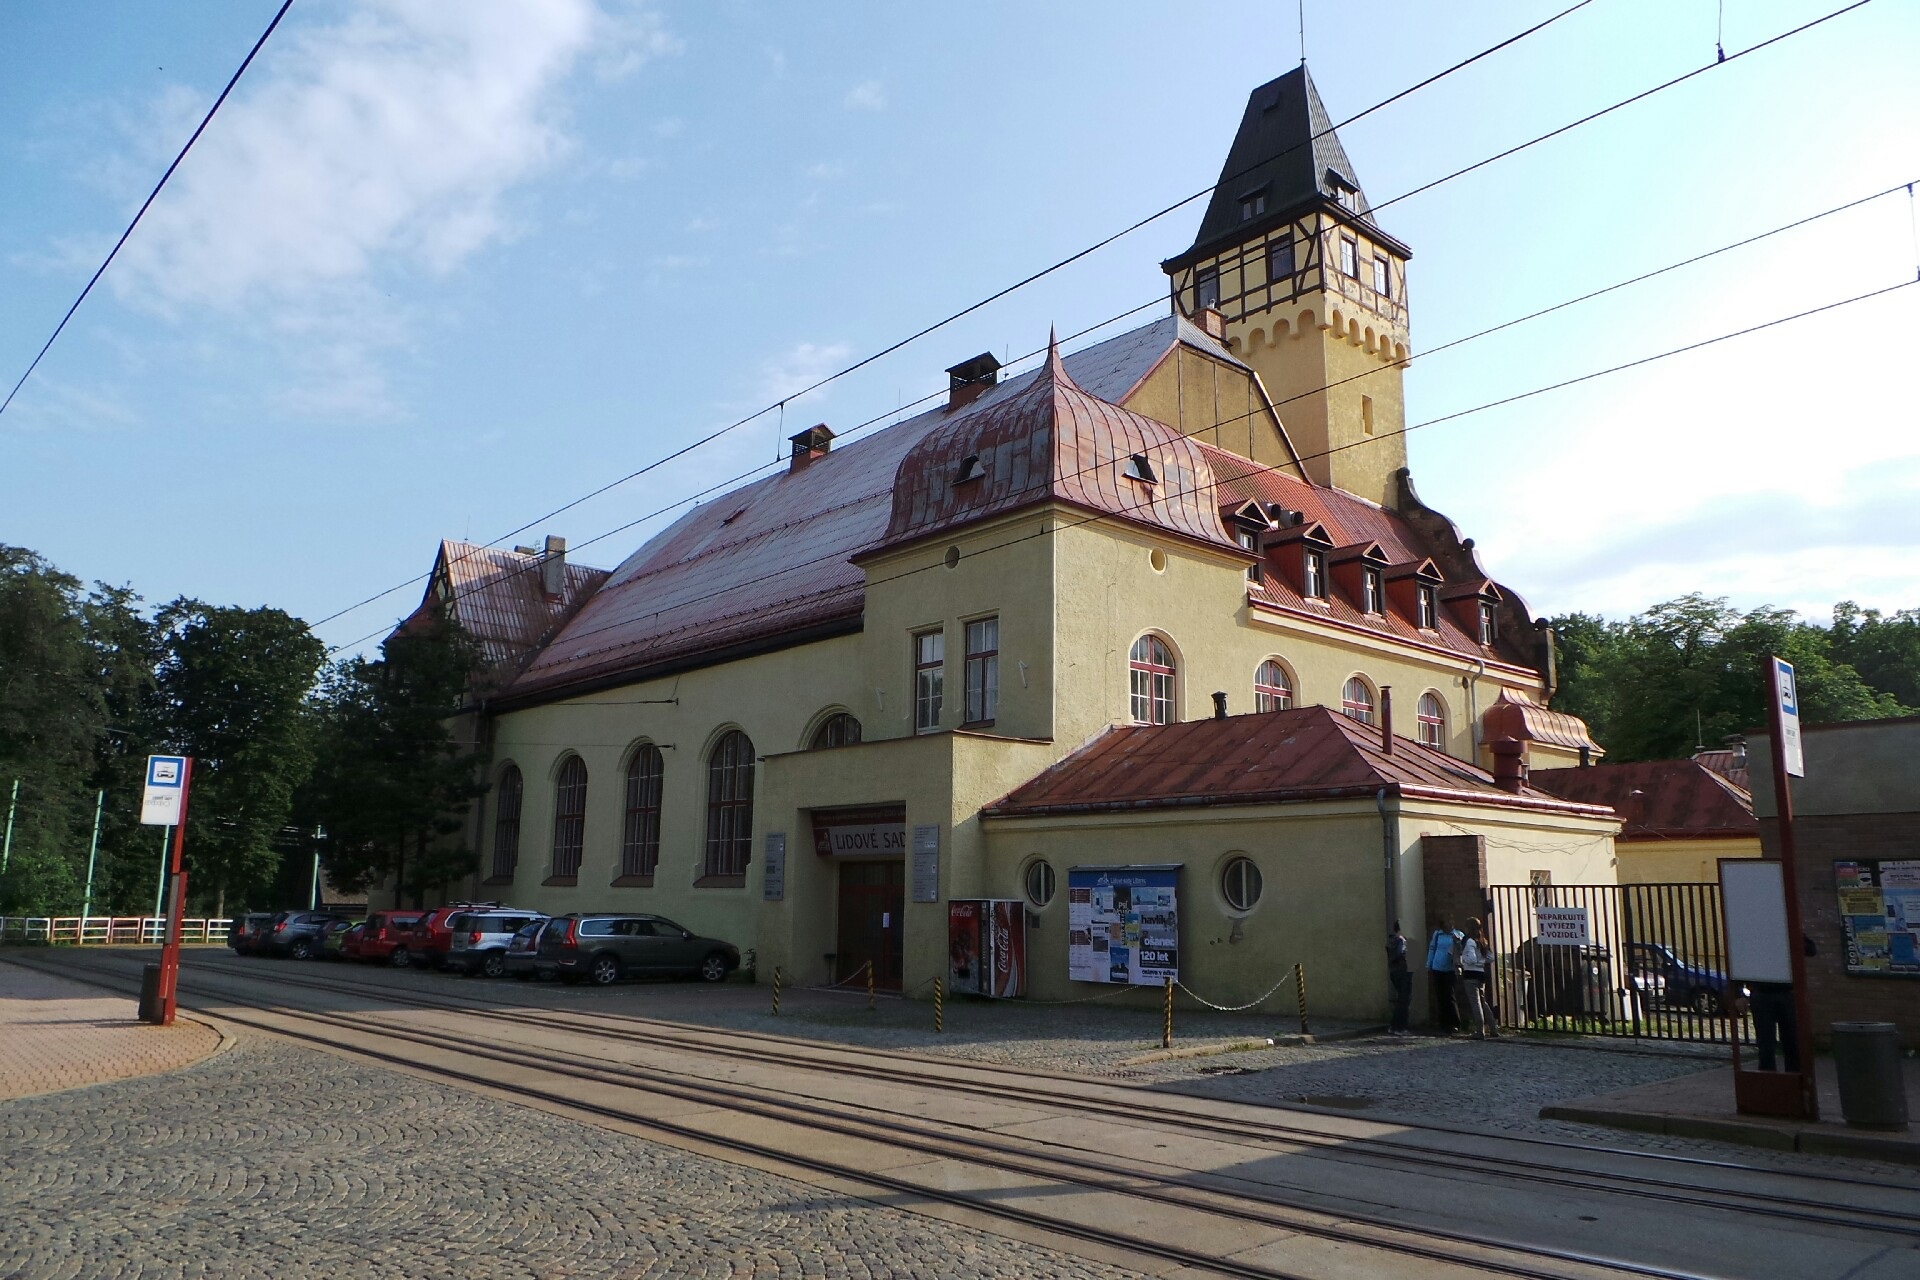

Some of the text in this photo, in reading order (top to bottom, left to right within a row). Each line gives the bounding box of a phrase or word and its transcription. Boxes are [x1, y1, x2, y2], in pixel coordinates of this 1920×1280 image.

[835, 828, 878, 850] LIDOVÉ
[1547, 921, 1576, 929] VÝJEZD
[1140, 951, 1169, 961] 120 let
